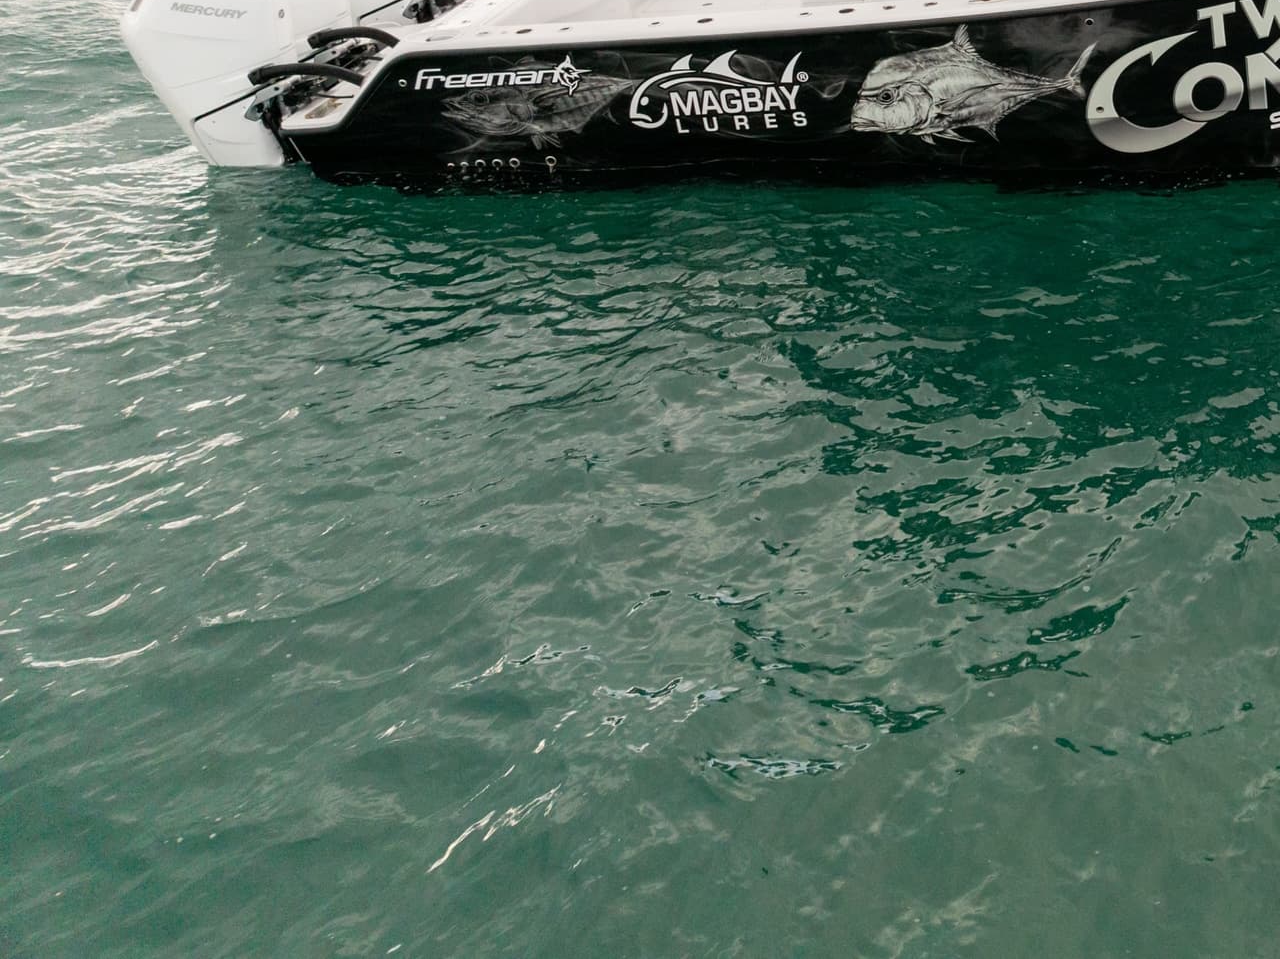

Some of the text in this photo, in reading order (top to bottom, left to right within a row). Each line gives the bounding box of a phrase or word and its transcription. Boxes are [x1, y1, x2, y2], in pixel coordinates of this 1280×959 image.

[170, 1, 247, 19] MERCURY
[414, 68, 562, 90] freeman
[669, 85, 800, 116] MAGBAY
[676, 111, 808, 134] LURES
